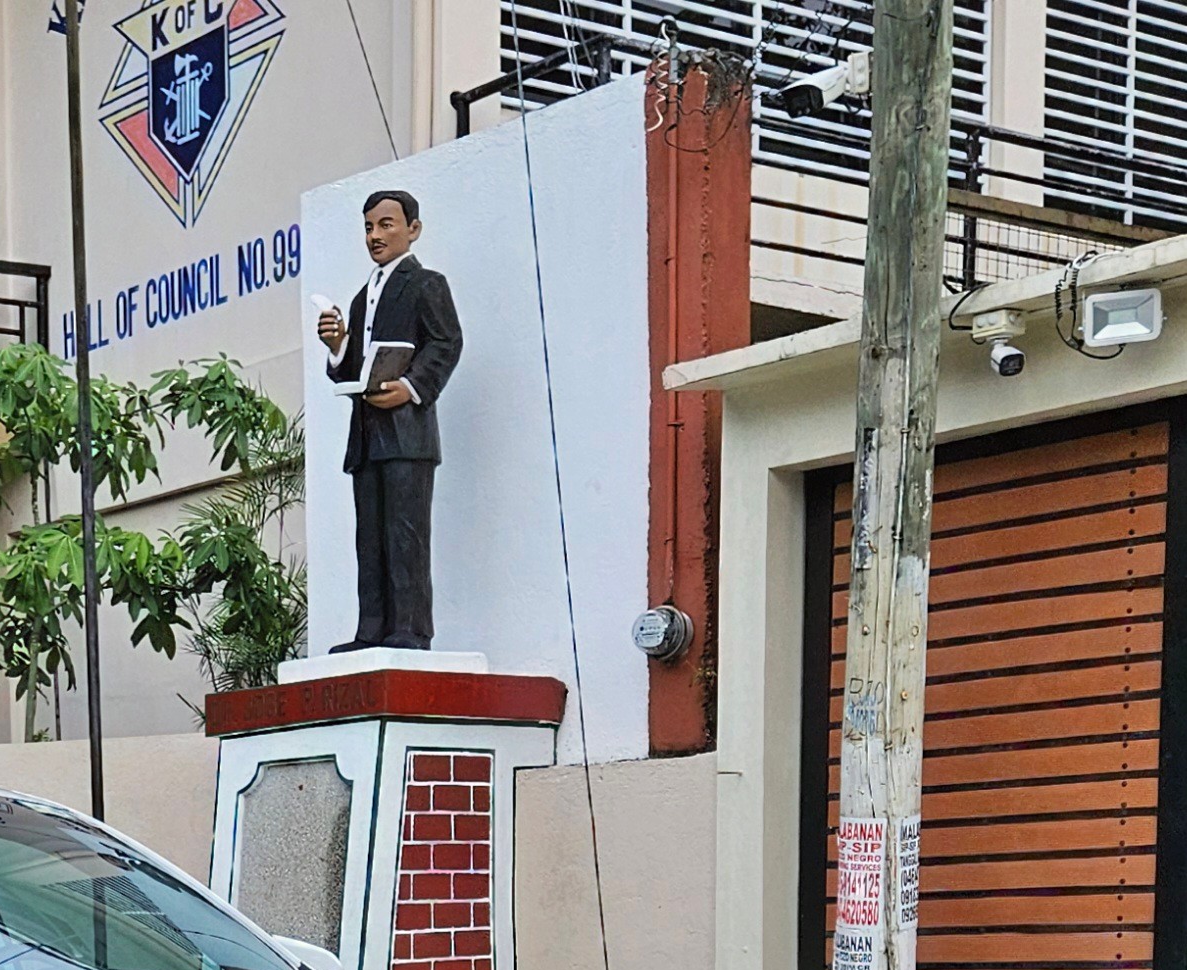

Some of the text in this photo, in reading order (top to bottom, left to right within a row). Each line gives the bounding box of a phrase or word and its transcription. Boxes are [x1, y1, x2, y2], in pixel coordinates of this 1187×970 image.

[151, 6, 170, 52] K
[175, 0, 196, 34] OF
[63, 299, 109, 360] HLL
[116, 285, 139, 340] OF
[146, 253, 228, 329] COUNCIL
[847, 854, 882, 863] NEGRO
